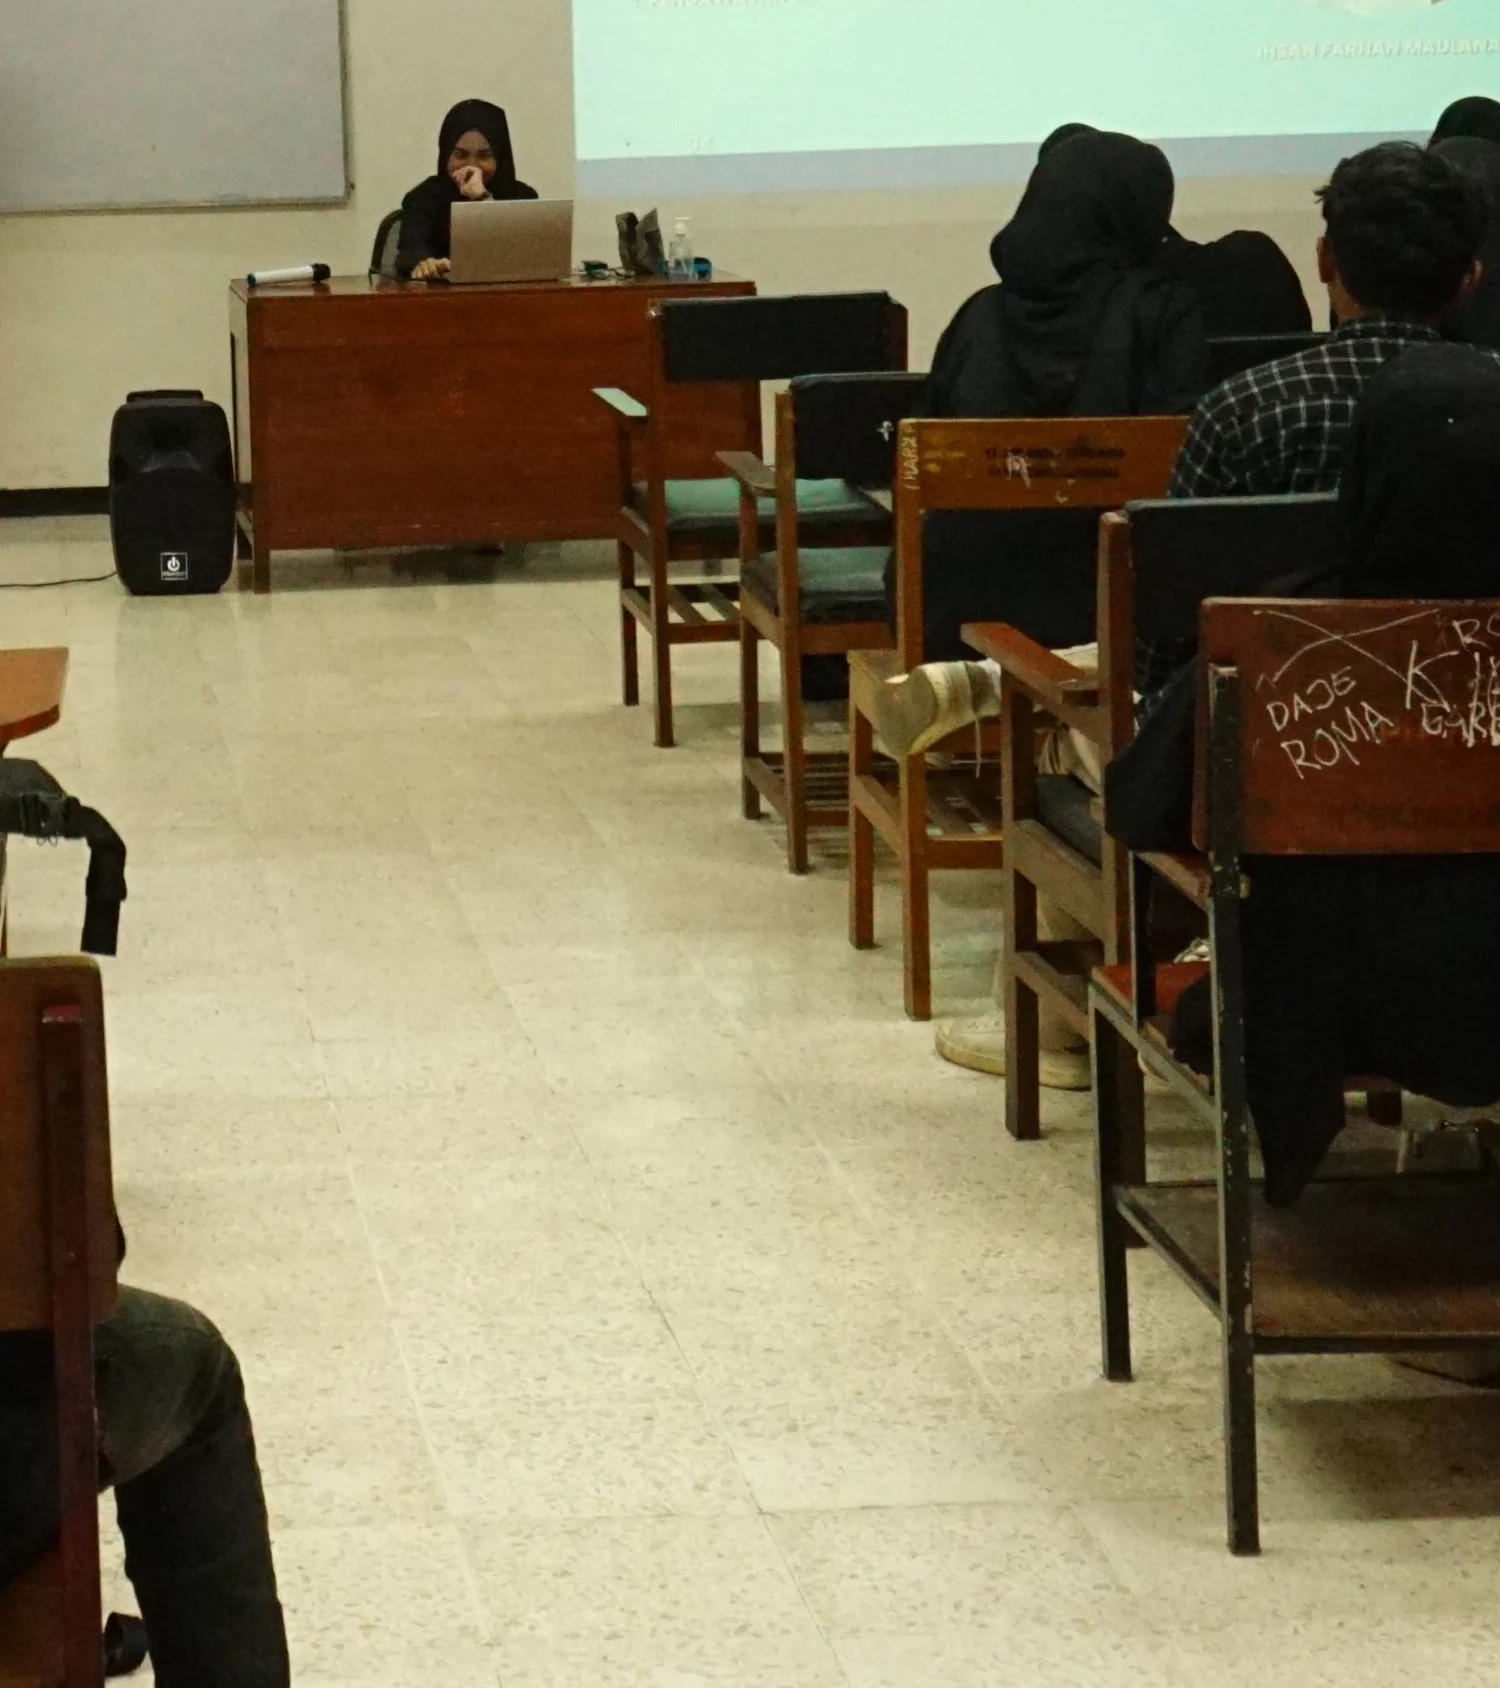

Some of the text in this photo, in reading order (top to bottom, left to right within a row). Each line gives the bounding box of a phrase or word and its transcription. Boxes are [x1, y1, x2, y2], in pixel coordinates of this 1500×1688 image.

[1255, 41, 1319, 61] IHSAN
[1321, 39, 1403, 60] FARHAN
[1279, 701, 1394, 780] ROMA
